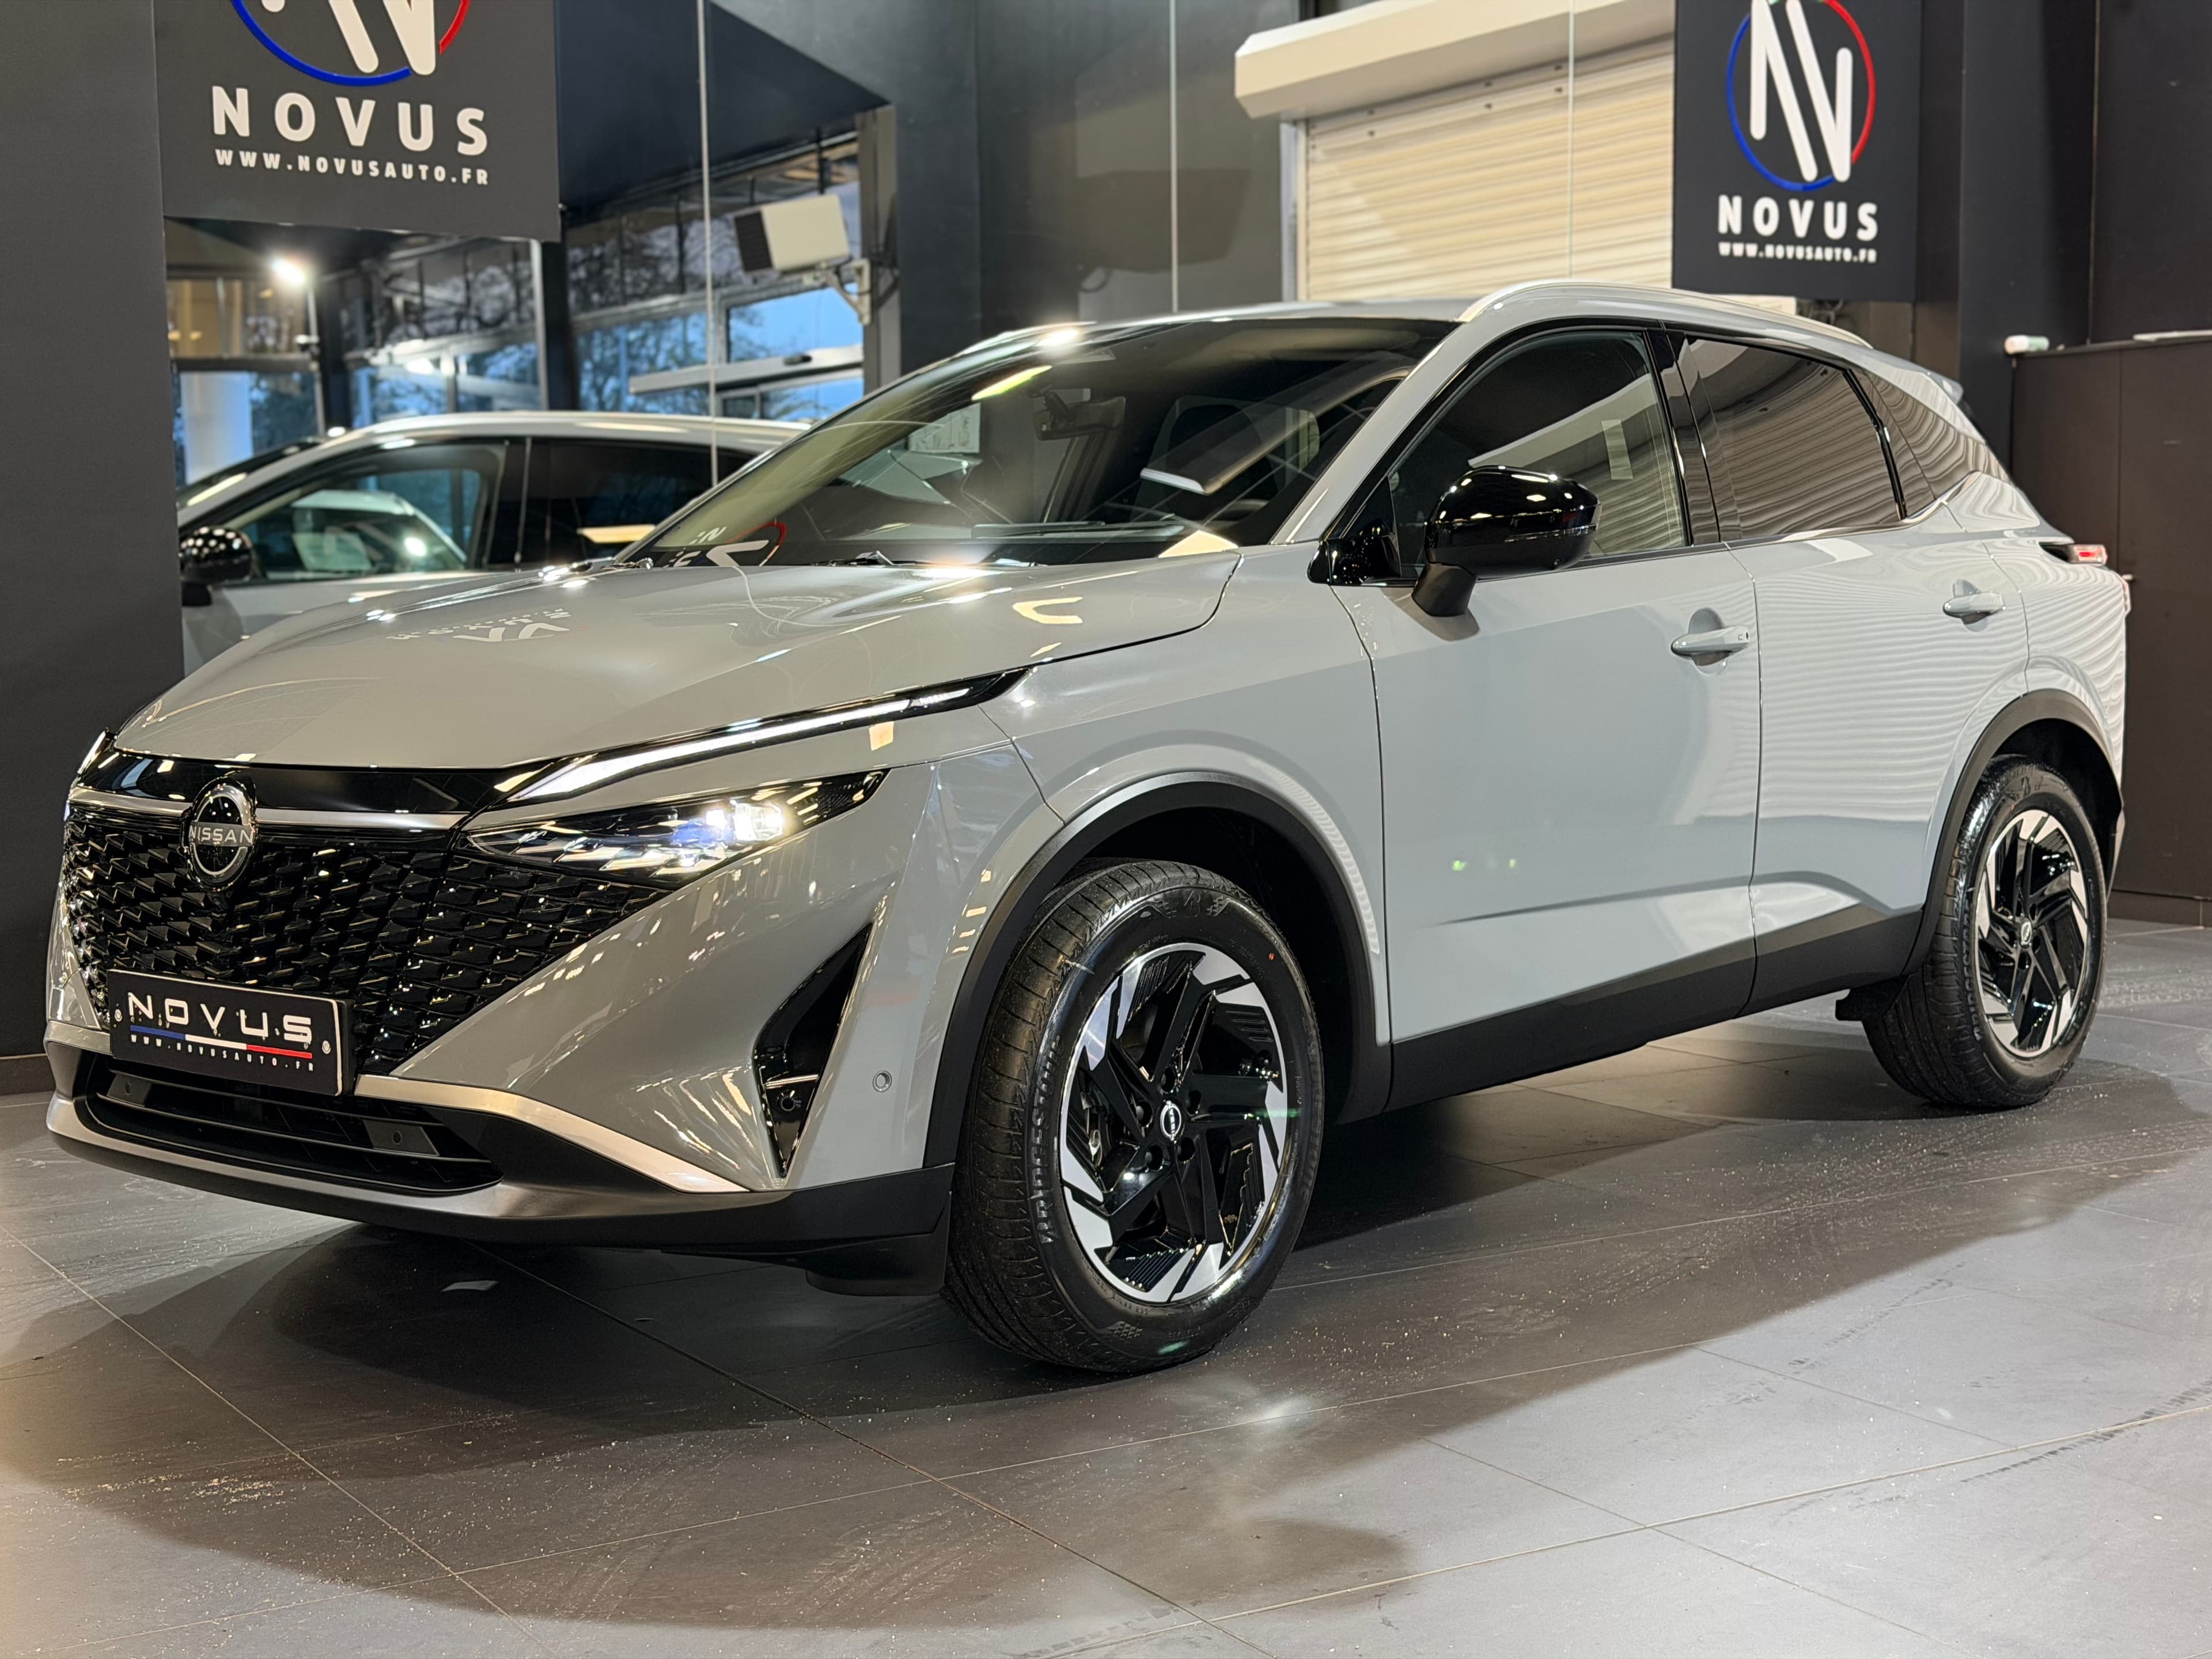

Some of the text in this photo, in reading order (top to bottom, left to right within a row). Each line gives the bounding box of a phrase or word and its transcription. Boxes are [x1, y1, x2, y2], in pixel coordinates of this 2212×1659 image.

[212, 86, 488, 156] NOVUS
[215, 149, 488, 185] WWW.NOVUSAUTO.FR
[1718, 195, 1878, 241] NOVUS
[1718, 242, 1877, 263] WWW.NOVUSAUTO.FR
[189, 824, 255, 844] NISSAN
[127, 992, 312, 1043] NOVUS
[131, 1035, 314, 1071] WWW.NOVUSAUTO.FR
